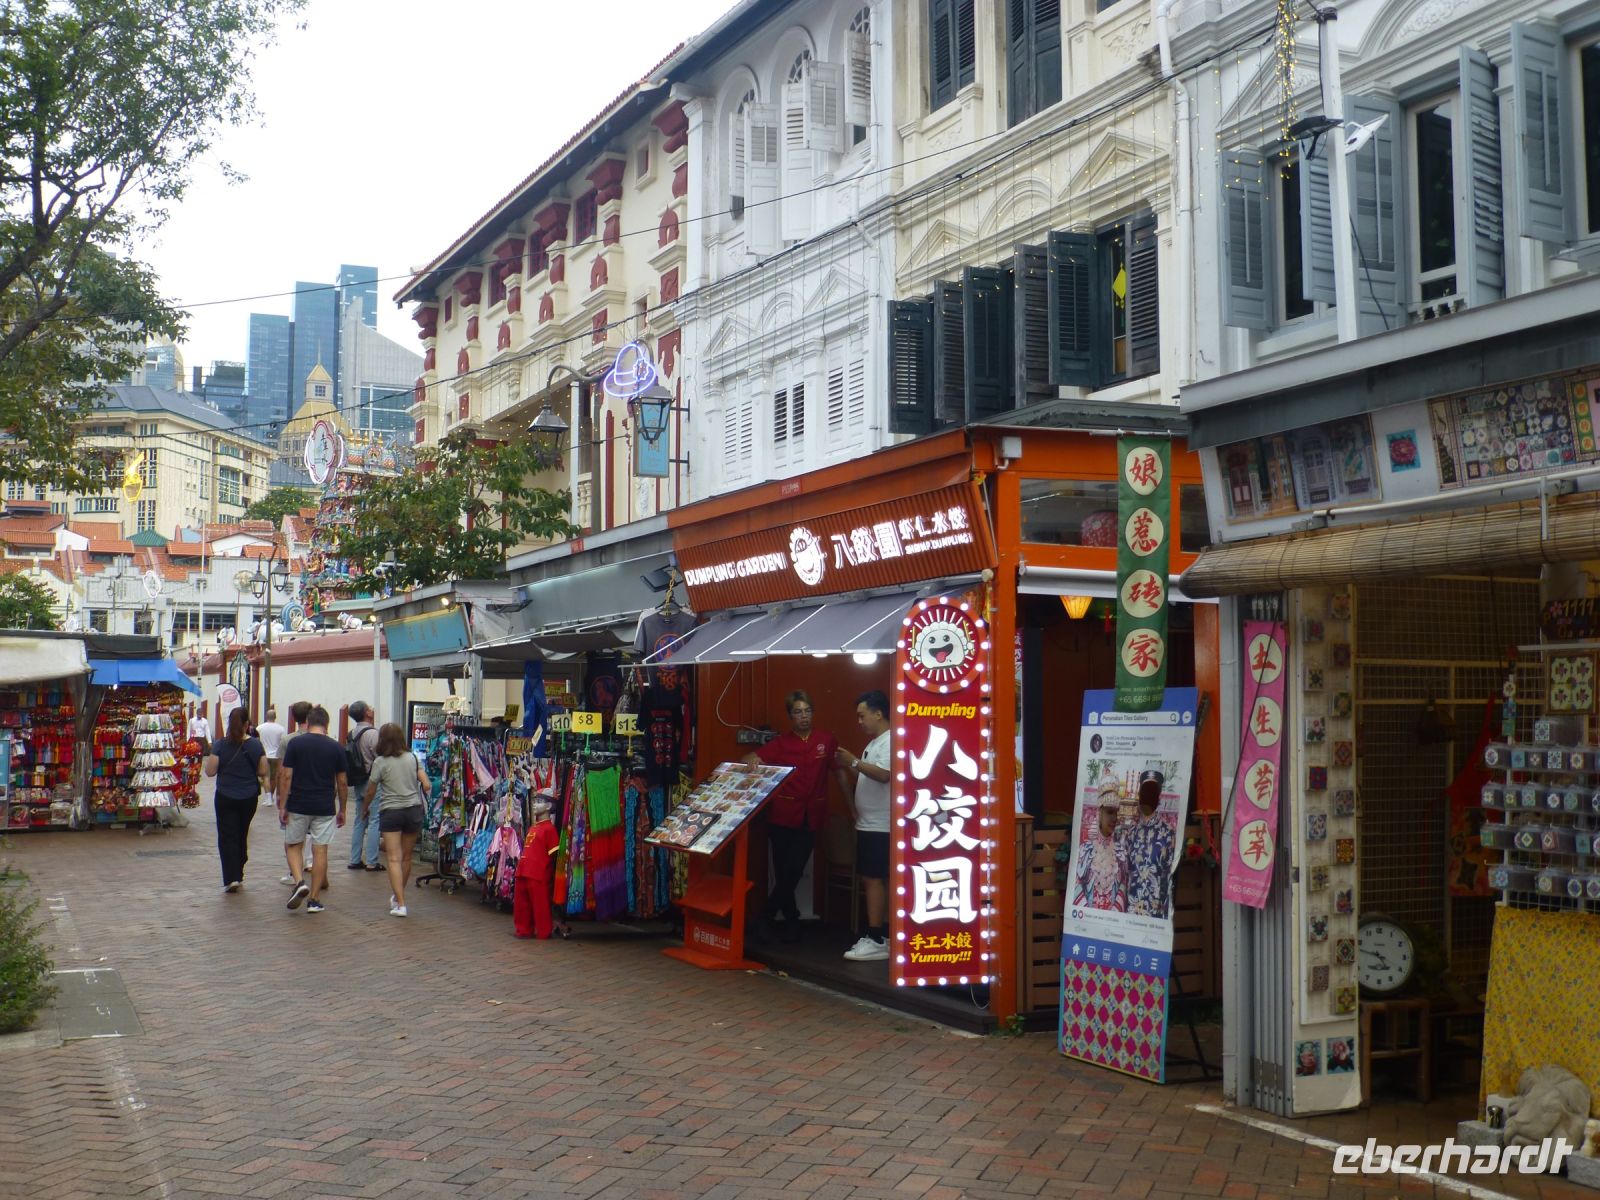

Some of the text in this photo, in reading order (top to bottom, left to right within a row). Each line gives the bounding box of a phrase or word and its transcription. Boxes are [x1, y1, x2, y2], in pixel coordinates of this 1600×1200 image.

[684, 552, 786, 587] DUMPLING GARDEN
[906, 702, 977, 719] Dumpling
[554, 717, 570, 729] $10
[578, 714, 594, 725] $8
[904, 724, 981, 925] 八饺园
[909, 931, 973, 951] 手工水餃
[910, 951, 972, 963] Yummy!!!
